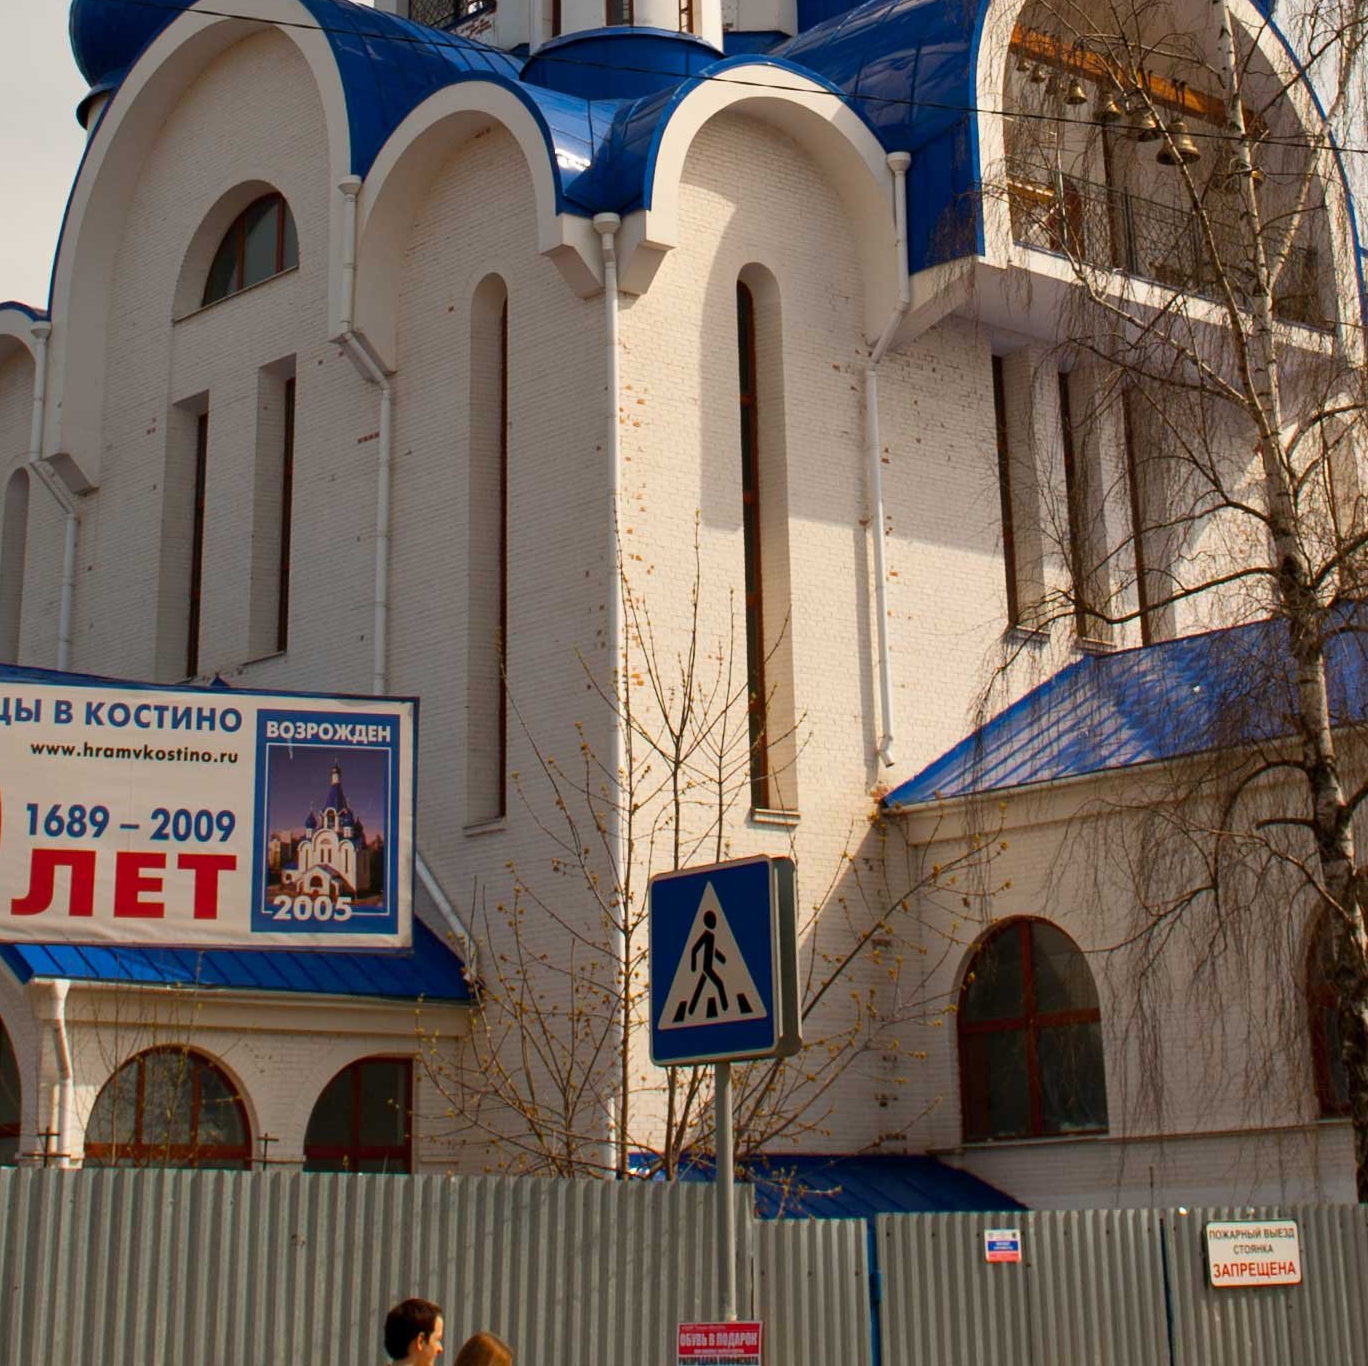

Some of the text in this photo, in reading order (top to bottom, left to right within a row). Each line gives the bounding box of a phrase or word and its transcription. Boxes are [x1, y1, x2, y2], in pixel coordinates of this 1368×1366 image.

[54, 700, 73, 724] В
[85, 701, 242, 732] КОСТИНО
[266, 720, 391, 744] ВОЗРОЖДЕН
[30, 742, 239, 764] www.hramvkostino.ru
[26, 803, 110, 838] 1689
[150, 807, 236, 842] 2009
[11, 848, 237, 920] ЛЕТ
[272, 894, 353, 921] 2005
[1209, 1227, 1295, 1240] ПОЖАРНЫЙ ВЫЕЗД
[1233, 1243, 1273, 1254] СТОЯНКА
[1212, 1261, 1296, 1278] ЗАПРЕЩЕНА
